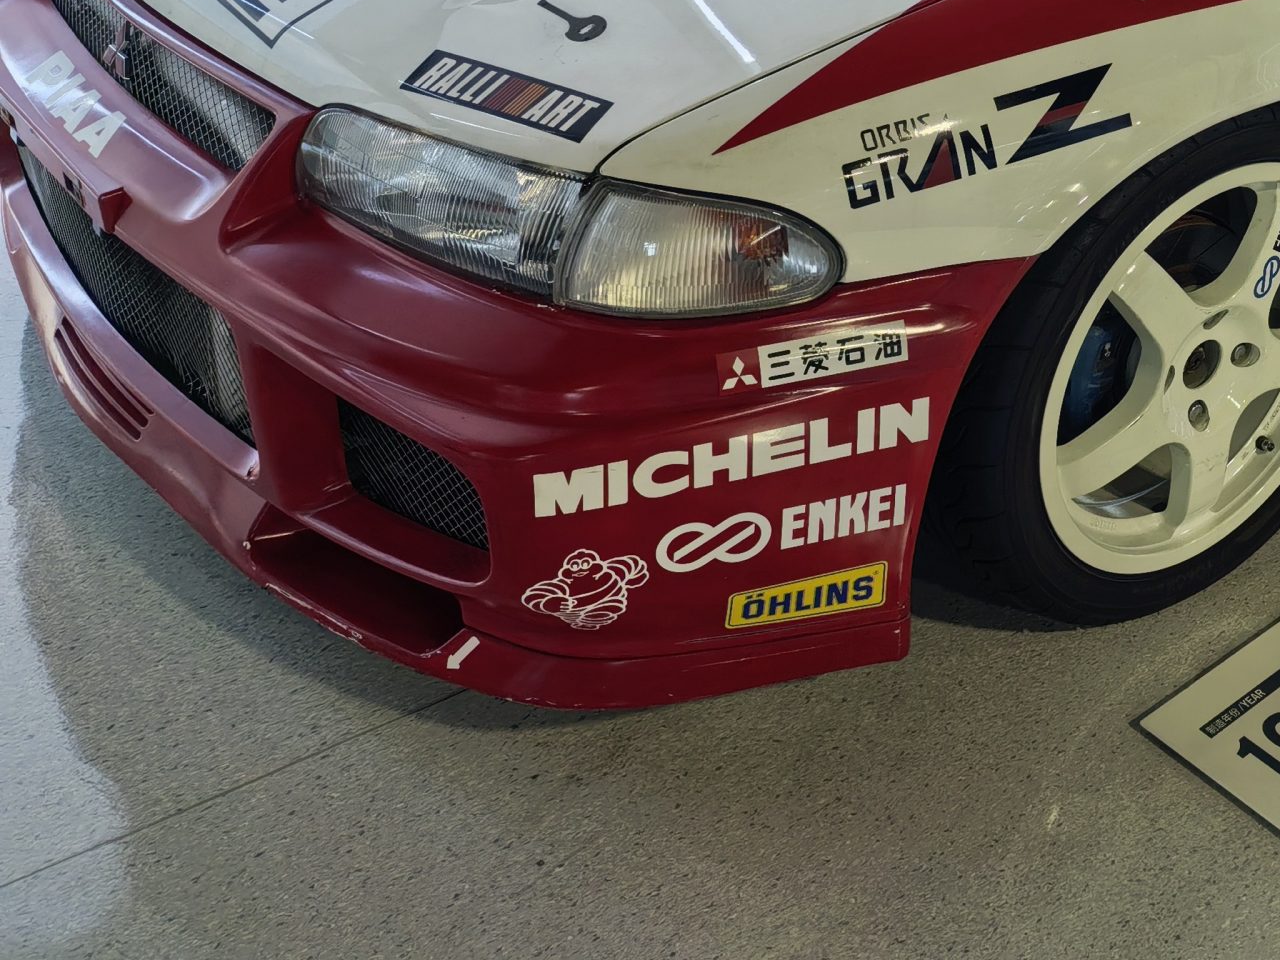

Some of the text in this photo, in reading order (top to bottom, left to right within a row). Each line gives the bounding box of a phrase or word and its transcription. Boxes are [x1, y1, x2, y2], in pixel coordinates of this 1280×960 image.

[25, 50, 127, 159] PIAA
[415, 57, 601, 132] RALLI ART
[767, 330, 903, 382] 三菱石油
[533, 396, 930, 518] MICHELIN
[781, 483, 907, 550] ENKEI
[740, 575, 875, 620] ÖHLINS
[1204, 707, 1241, 735] 制造年份
